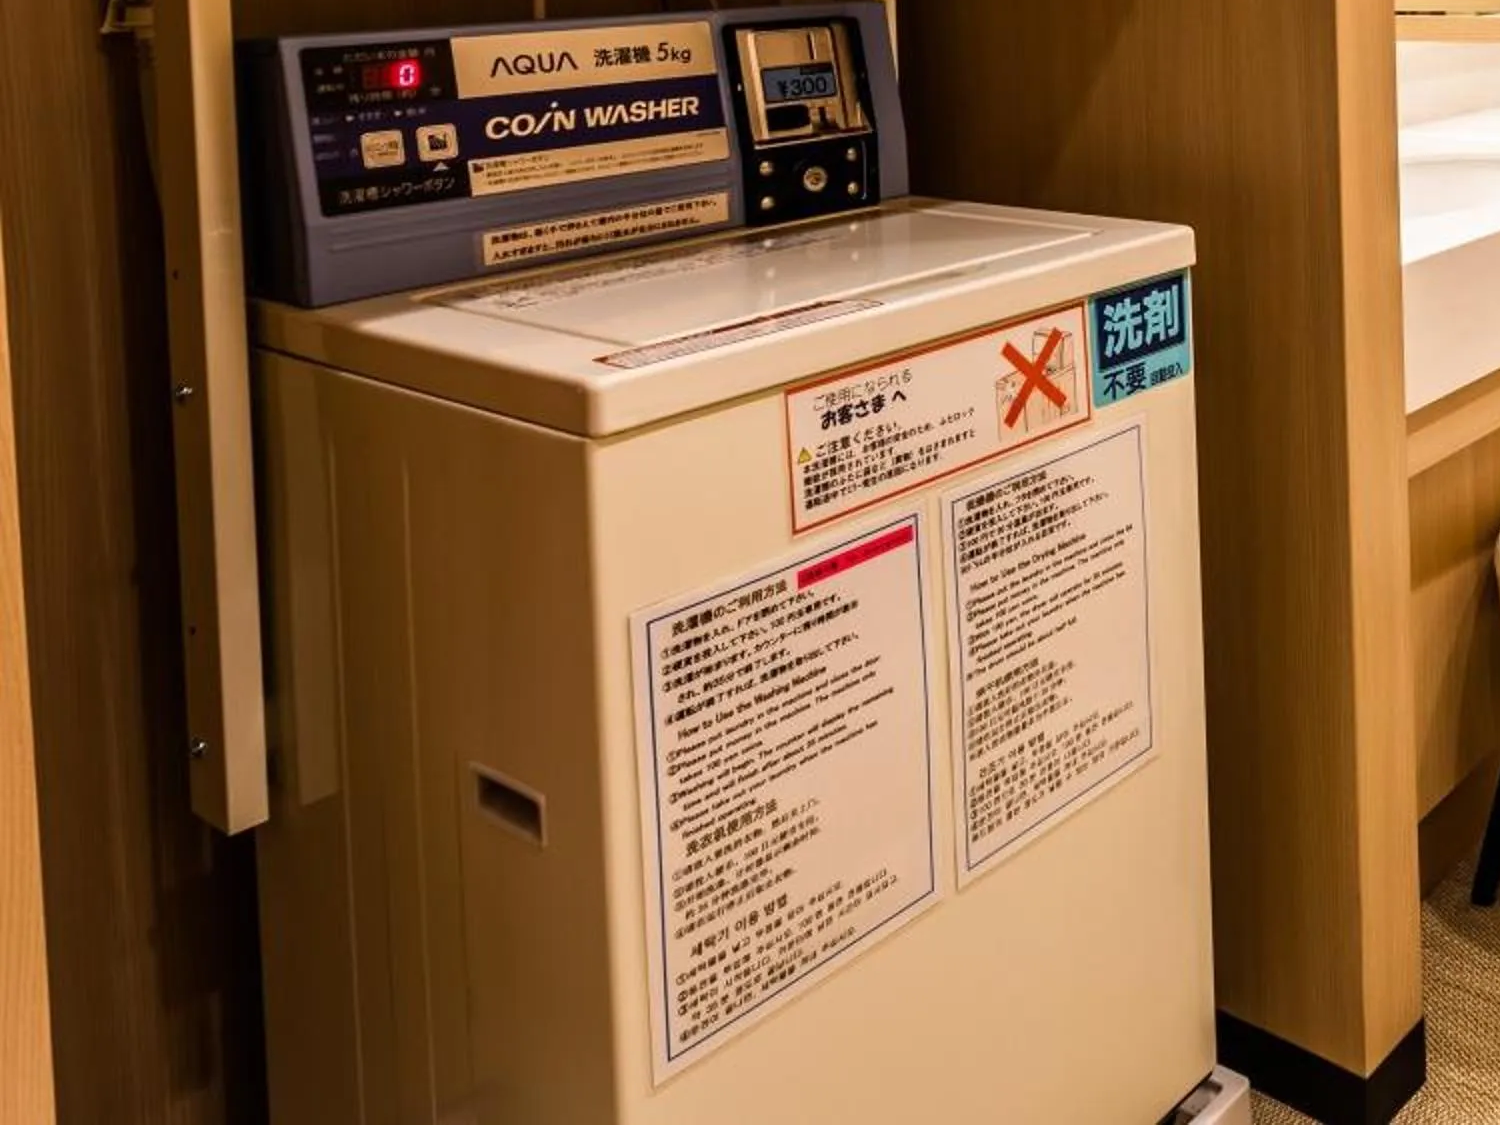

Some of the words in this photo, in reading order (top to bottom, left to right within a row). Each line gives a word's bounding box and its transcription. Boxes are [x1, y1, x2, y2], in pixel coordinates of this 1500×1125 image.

[490, 51, 579, 78] AQUA
[593, 45, 650, 68] 洗濯機
[656, 42, 692, 64] 5kg
[485, 101, 576, 140] COIN
[584, 96, 700, 127] WASHER
[1103, 283, 1180, 358] 洗剤
[813, 367, 912, 411] ご使用になられる
[1102, 362, 1149, 402] 不要
[820, 392, 886, 430] お客さま
[677, 721, 700, 743] How
